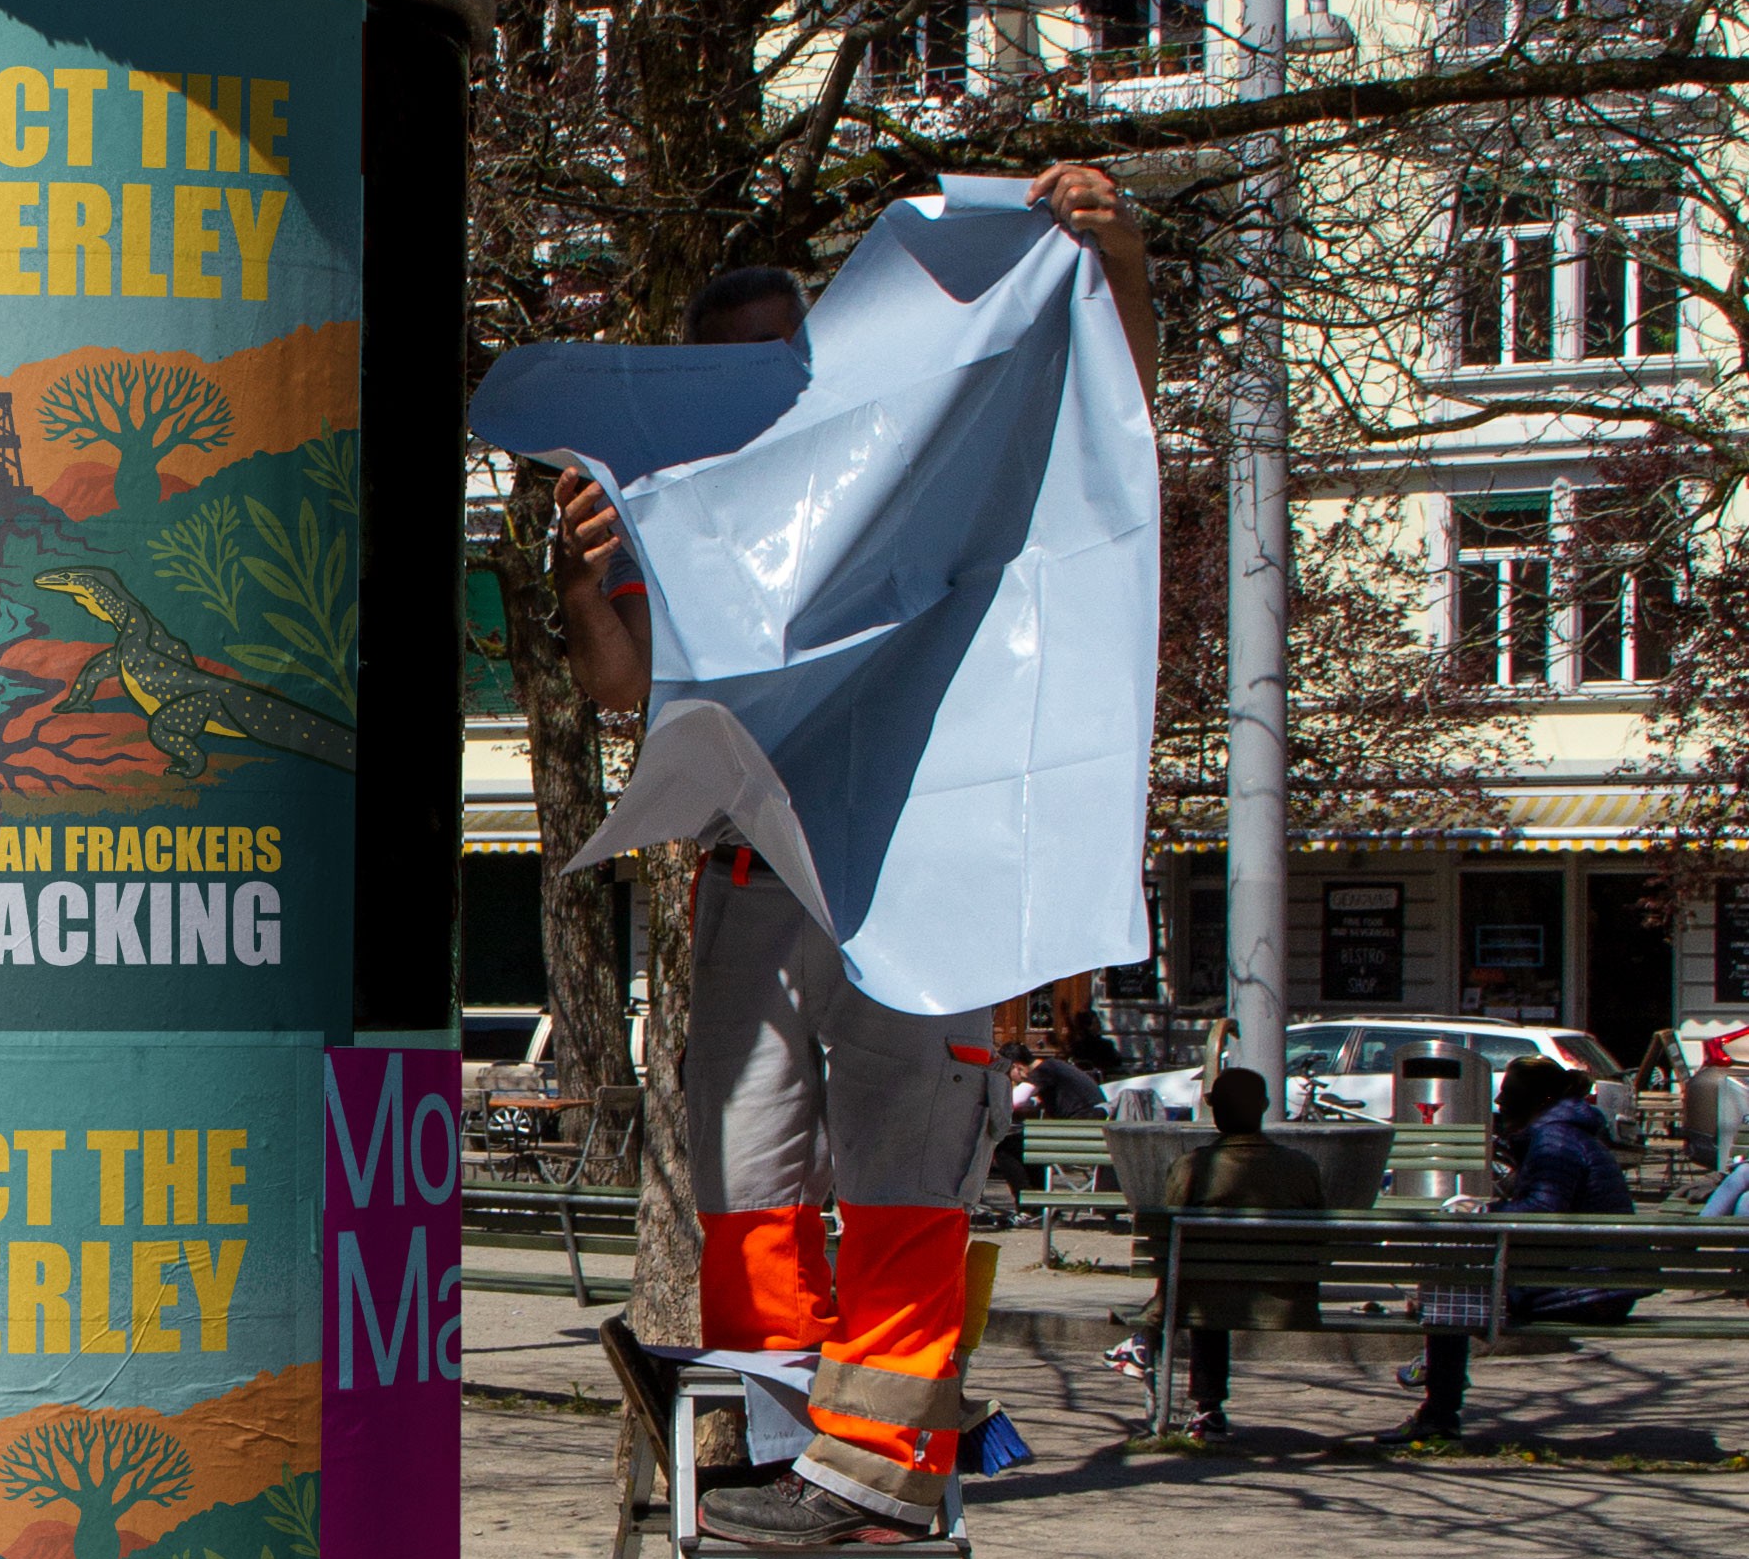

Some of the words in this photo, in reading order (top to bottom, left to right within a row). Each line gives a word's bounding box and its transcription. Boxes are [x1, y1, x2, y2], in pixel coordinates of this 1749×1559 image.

[122, 69, 291, 176] THE
[65, 825, 282, 873] FRACKERS
[86, 1128, 250, 1226] THE
